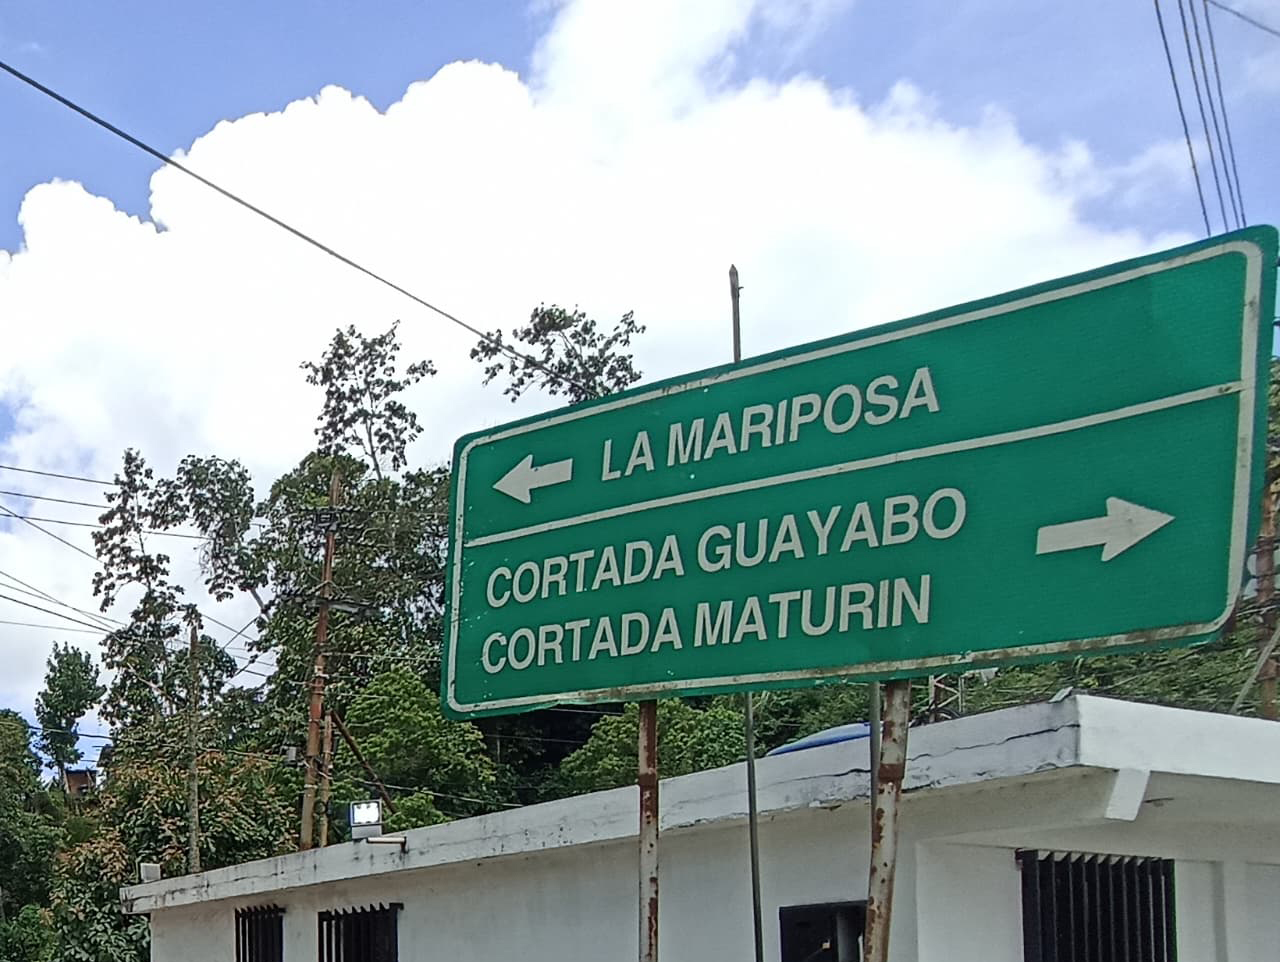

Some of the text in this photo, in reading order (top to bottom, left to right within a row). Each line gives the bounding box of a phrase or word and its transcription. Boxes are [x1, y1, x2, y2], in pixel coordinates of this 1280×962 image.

[601, 367, 940, 481] LA MARIPOSA
[486, 487, 967, 608] CORTADA GUAYABO
[481, 575, 931, 674] CORTADA MATURIN
